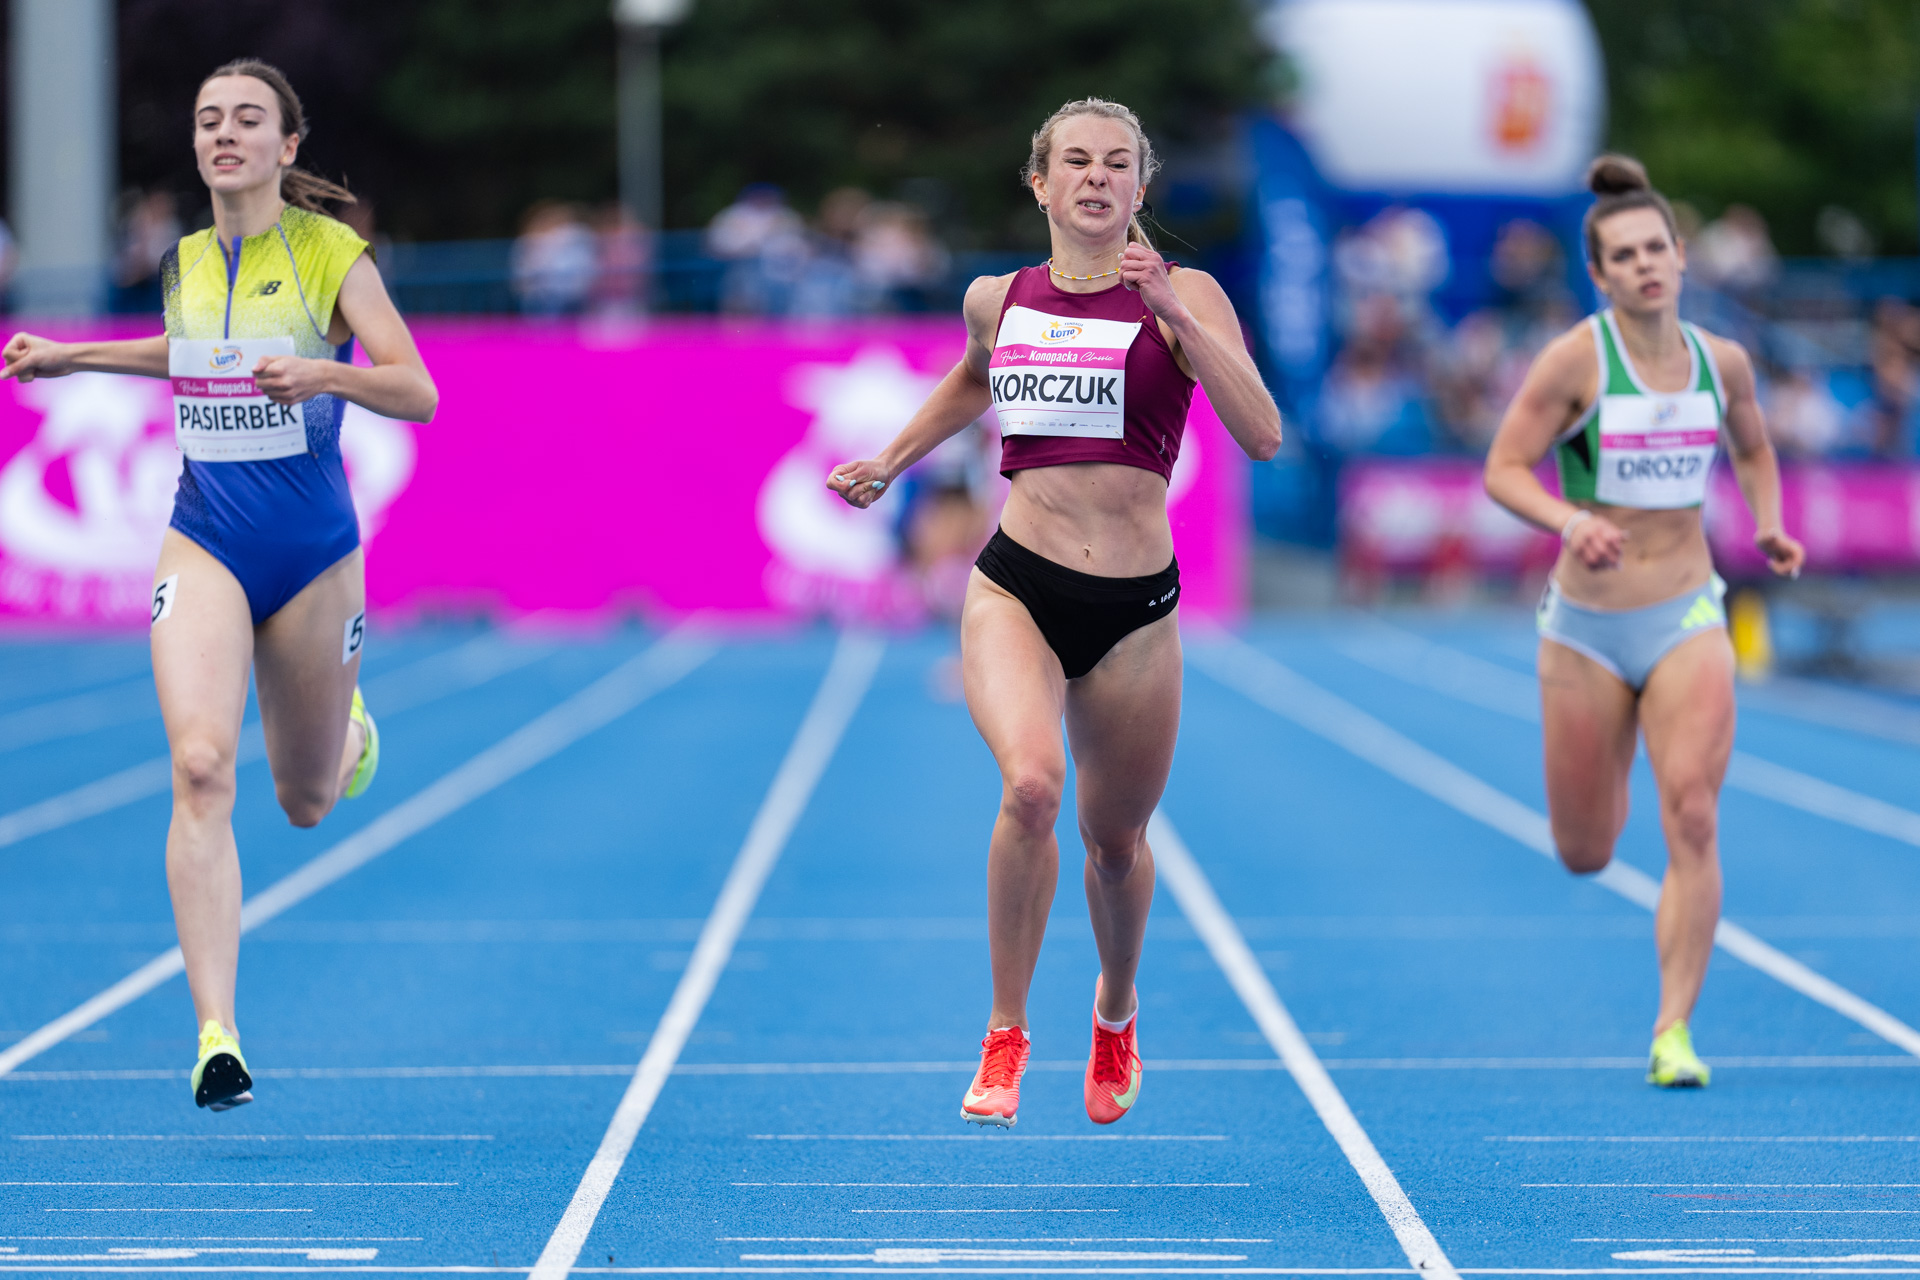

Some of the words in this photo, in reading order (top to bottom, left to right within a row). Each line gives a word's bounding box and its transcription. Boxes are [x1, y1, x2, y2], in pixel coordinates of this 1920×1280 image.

[1050, 329, 1076, 338] LOTTO
[1000, 350, 1027, 365] Halina
[1029, 350, 1078, 364] Konopacka
[1080, 351, 1114, 362] Classic
[207, 381, 252, 396] Konopacka
[992, 373, 1118, 405] KORCZUK
[179, 404, 298, 430] PASIERBEK
[152, 583, 167, 622] 5
[349, 613, 365, 652] 5
